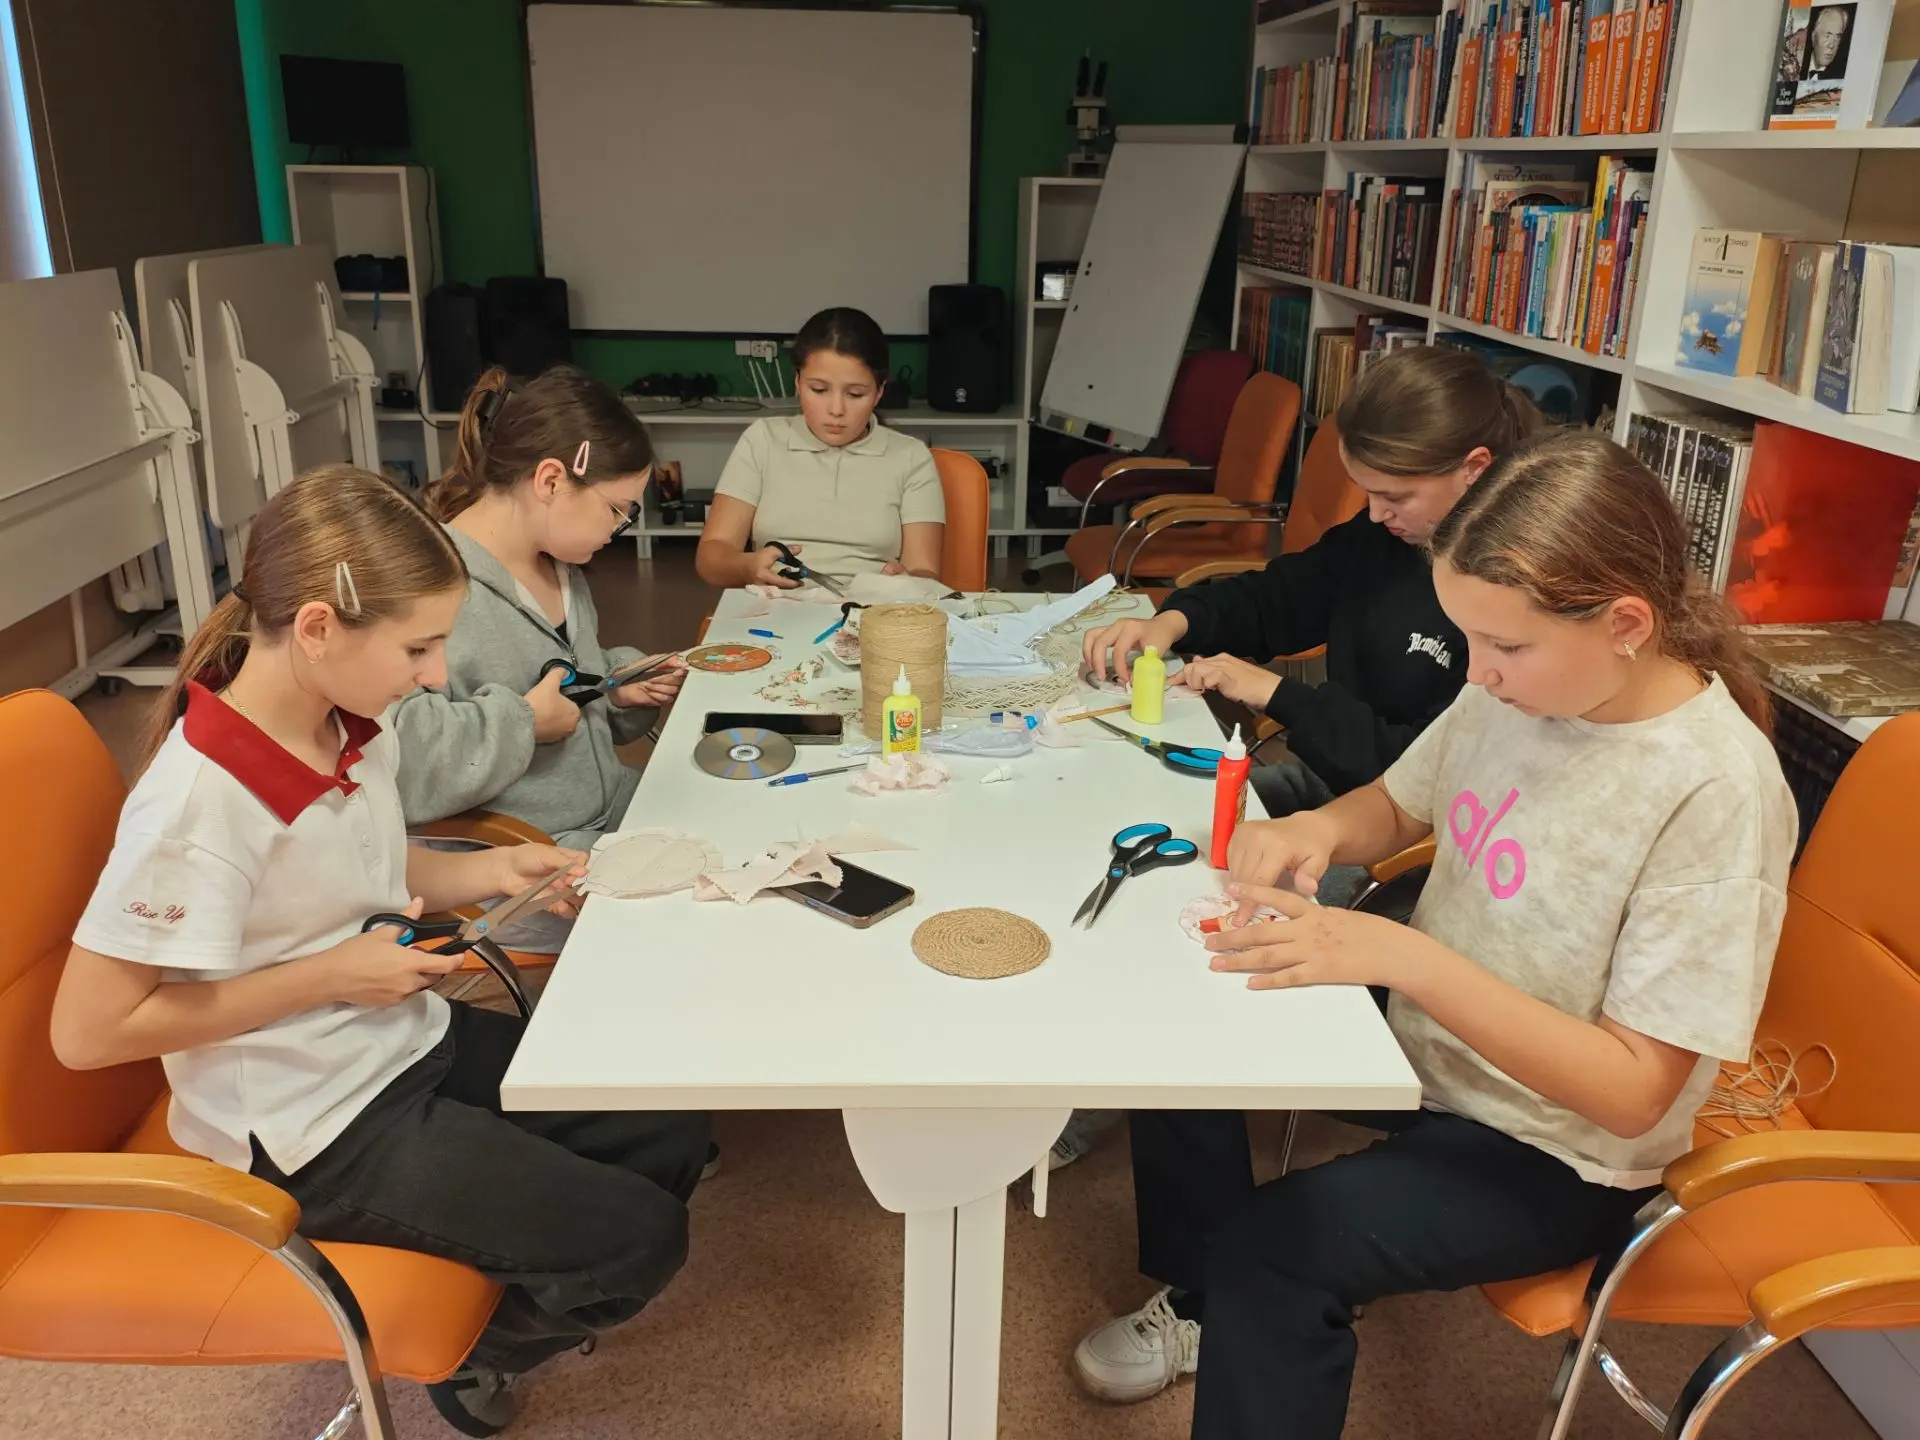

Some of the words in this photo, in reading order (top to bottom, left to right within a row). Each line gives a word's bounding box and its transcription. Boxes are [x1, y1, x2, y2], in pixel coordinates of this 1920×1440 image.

[1590, 19, 1607, 43] 82
[1615, 14, 1632, 39] 83
[1646, 7, 1663, 33] 85
[1637, 36, 1655, 128] ИСКУССТВО
[1597, 243, 1614, 267] 92
[122, 901, 158, 919] Rise
[164, 904, 185, 925] Up
